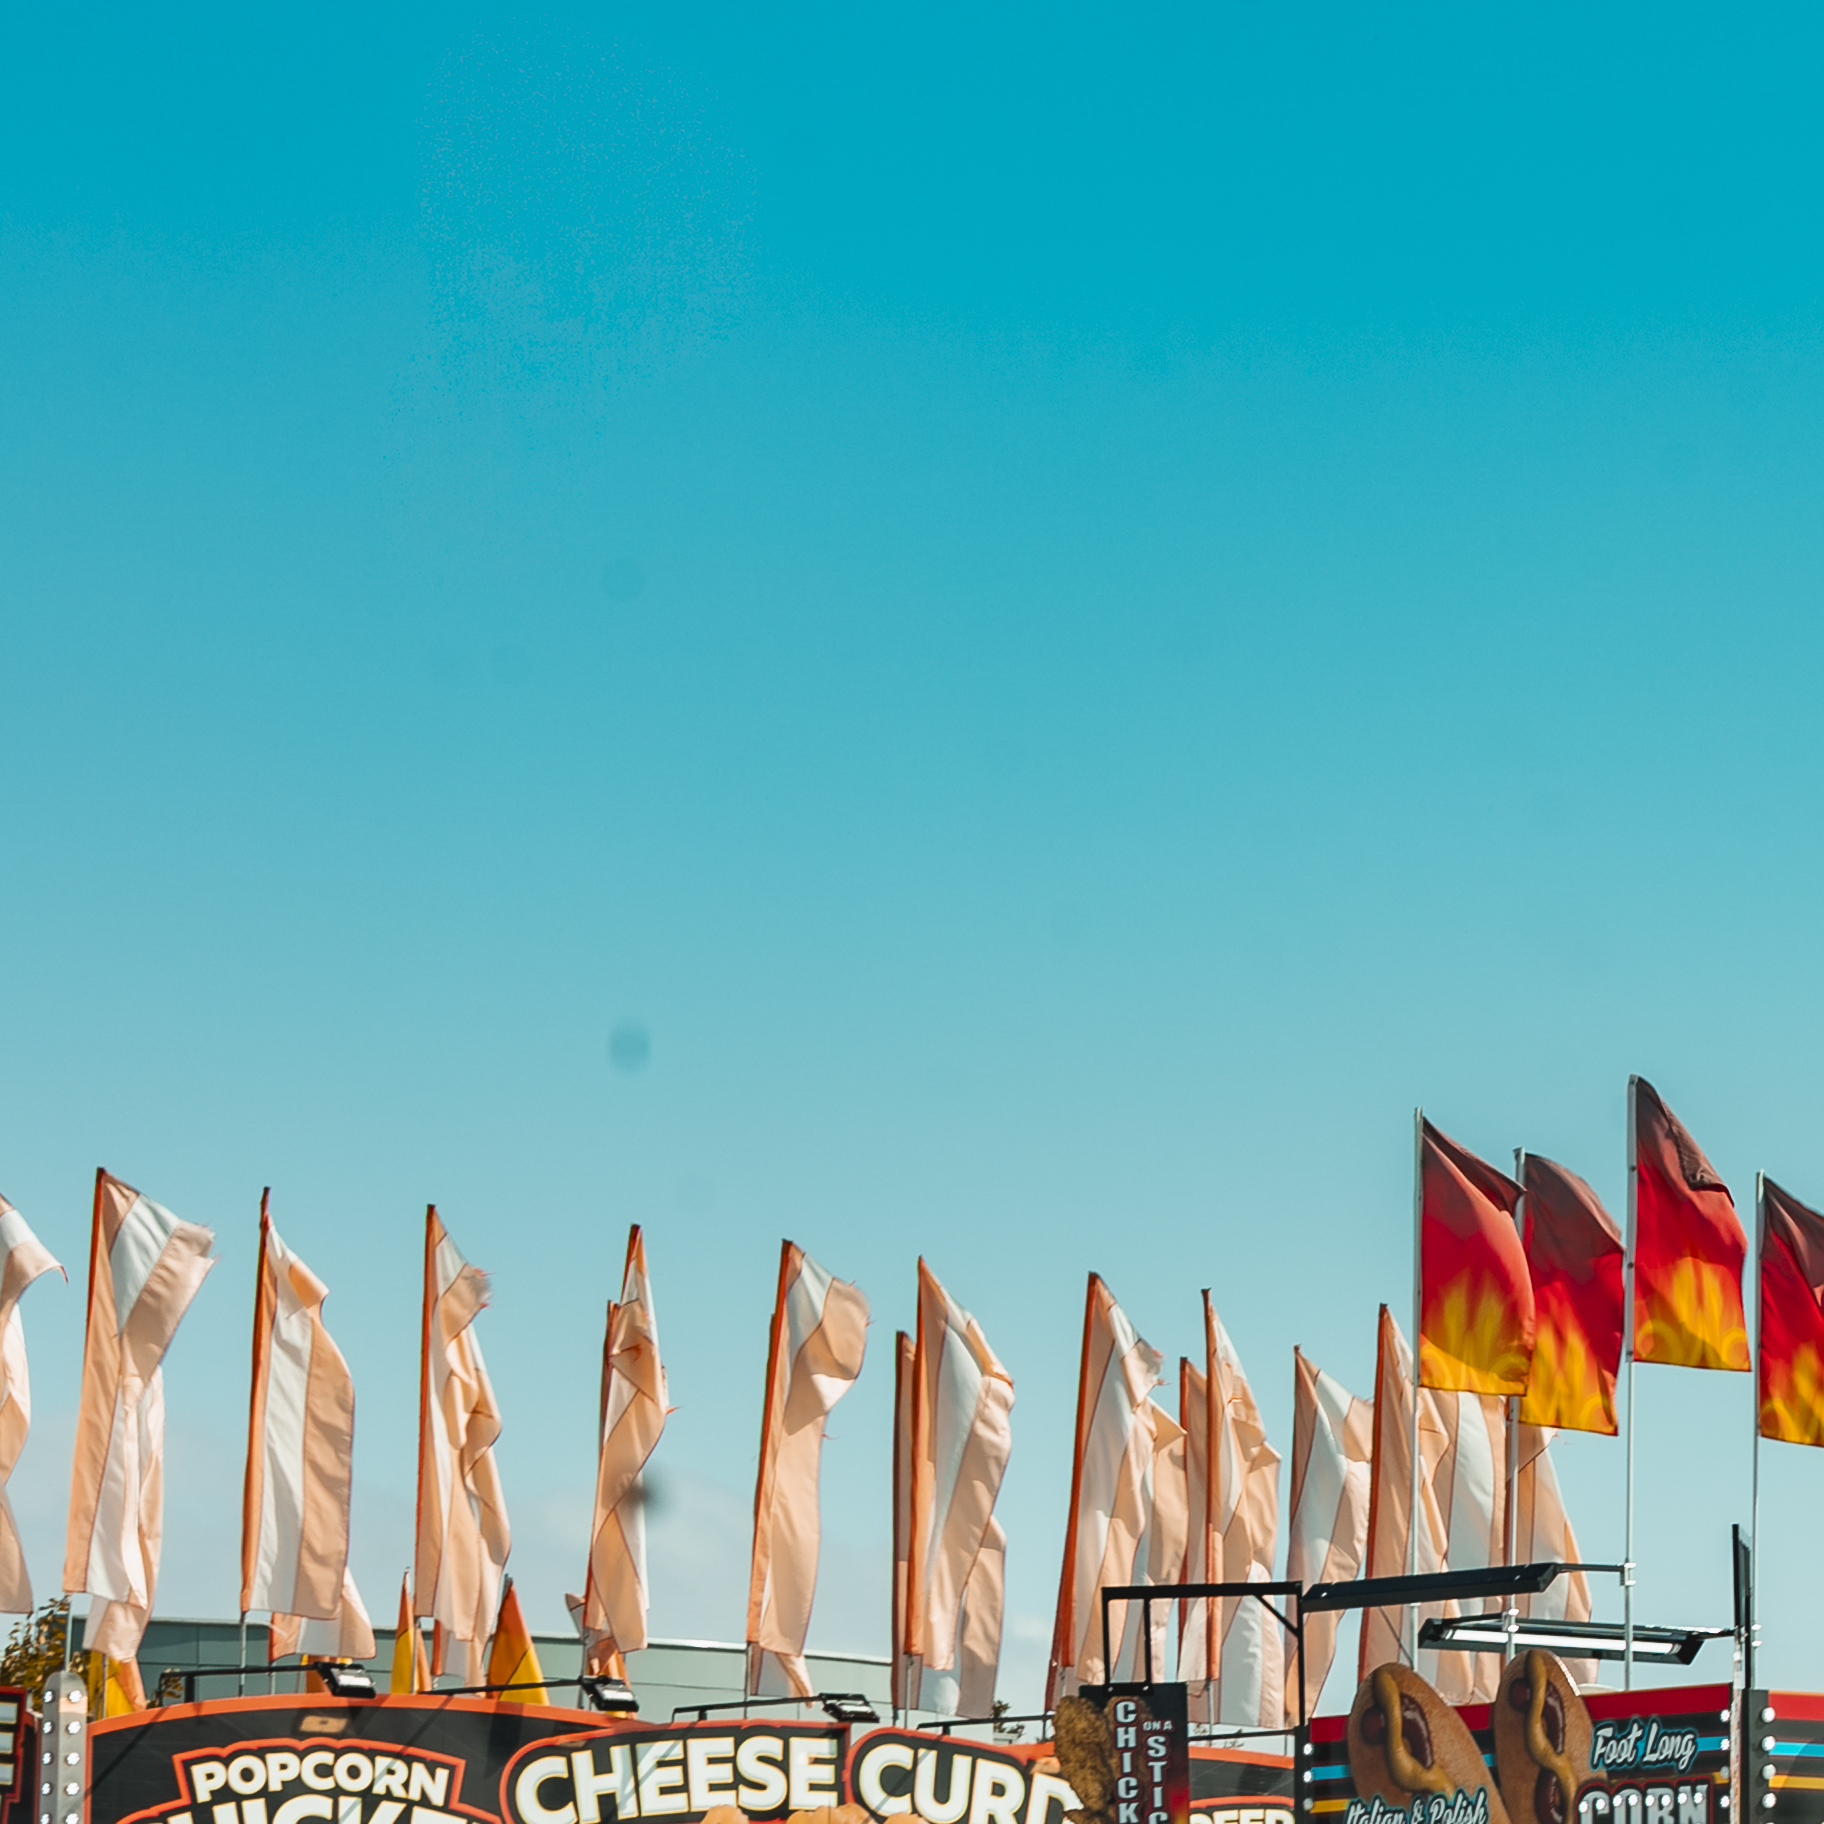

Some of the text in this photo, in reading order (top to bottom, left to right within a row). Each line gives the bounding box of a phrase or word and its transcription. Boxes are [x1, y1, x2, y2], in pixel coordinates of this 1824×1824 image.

[1594, 1724, 1695, 1772] Foot Long
[191, 1753, 449, 1804] POPCORN
